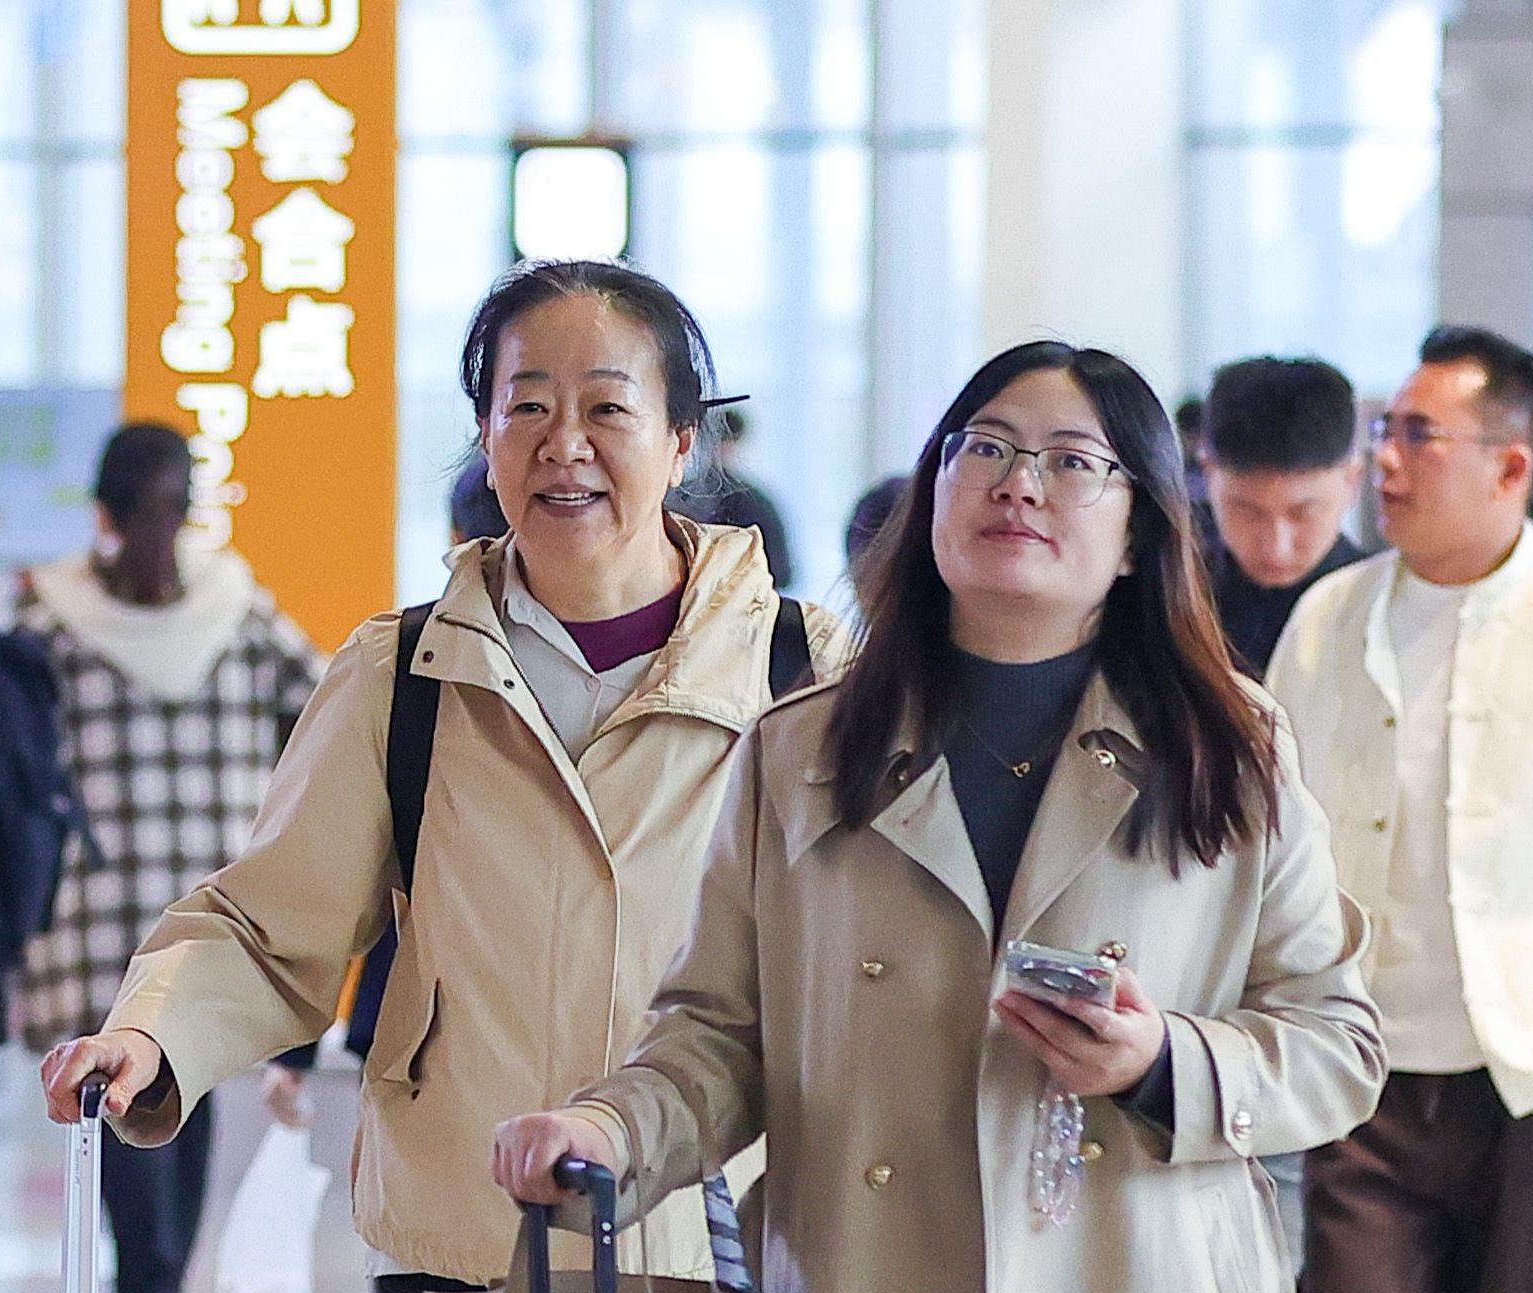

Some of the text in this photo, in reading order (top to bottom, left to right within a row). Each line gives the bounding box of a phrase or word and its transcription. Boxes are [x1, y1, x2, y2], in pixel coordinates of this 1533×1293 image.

[161, 77, 249, 551] Meeting Poin
[252, 79, 355, 400] 会合点
